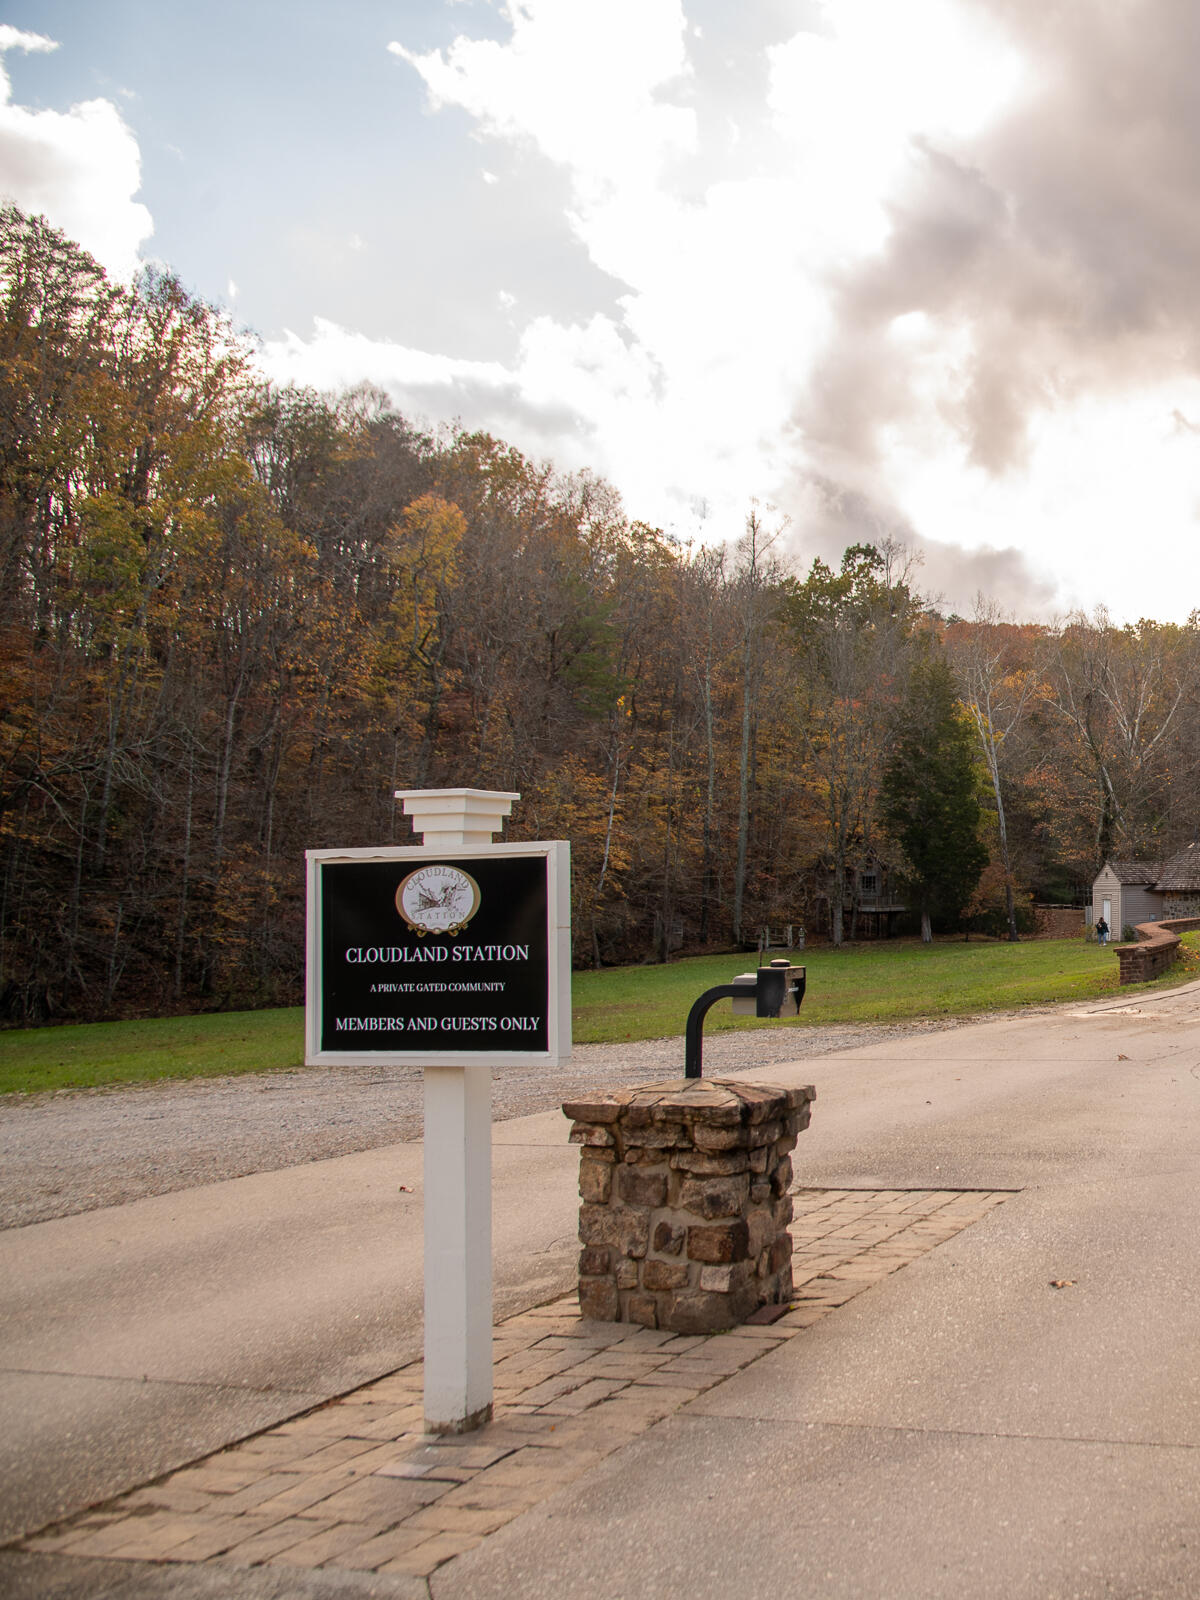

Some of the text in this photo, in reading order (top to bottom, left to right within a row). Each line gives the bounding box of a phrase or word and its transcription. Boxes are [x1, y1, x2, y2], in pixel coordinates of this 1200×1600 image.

[406, 867, 470, 891] CLOUDLAND
[411, 911, 466, 920] STATION
[345, 944, 530, 963] CLOUDLAND STATION
[370, 982, 506, 993] A PRIVATE GATED COMMUNITY
[335, 1016, 540, 1031] MEMBERS AND GUESTS ONLY
